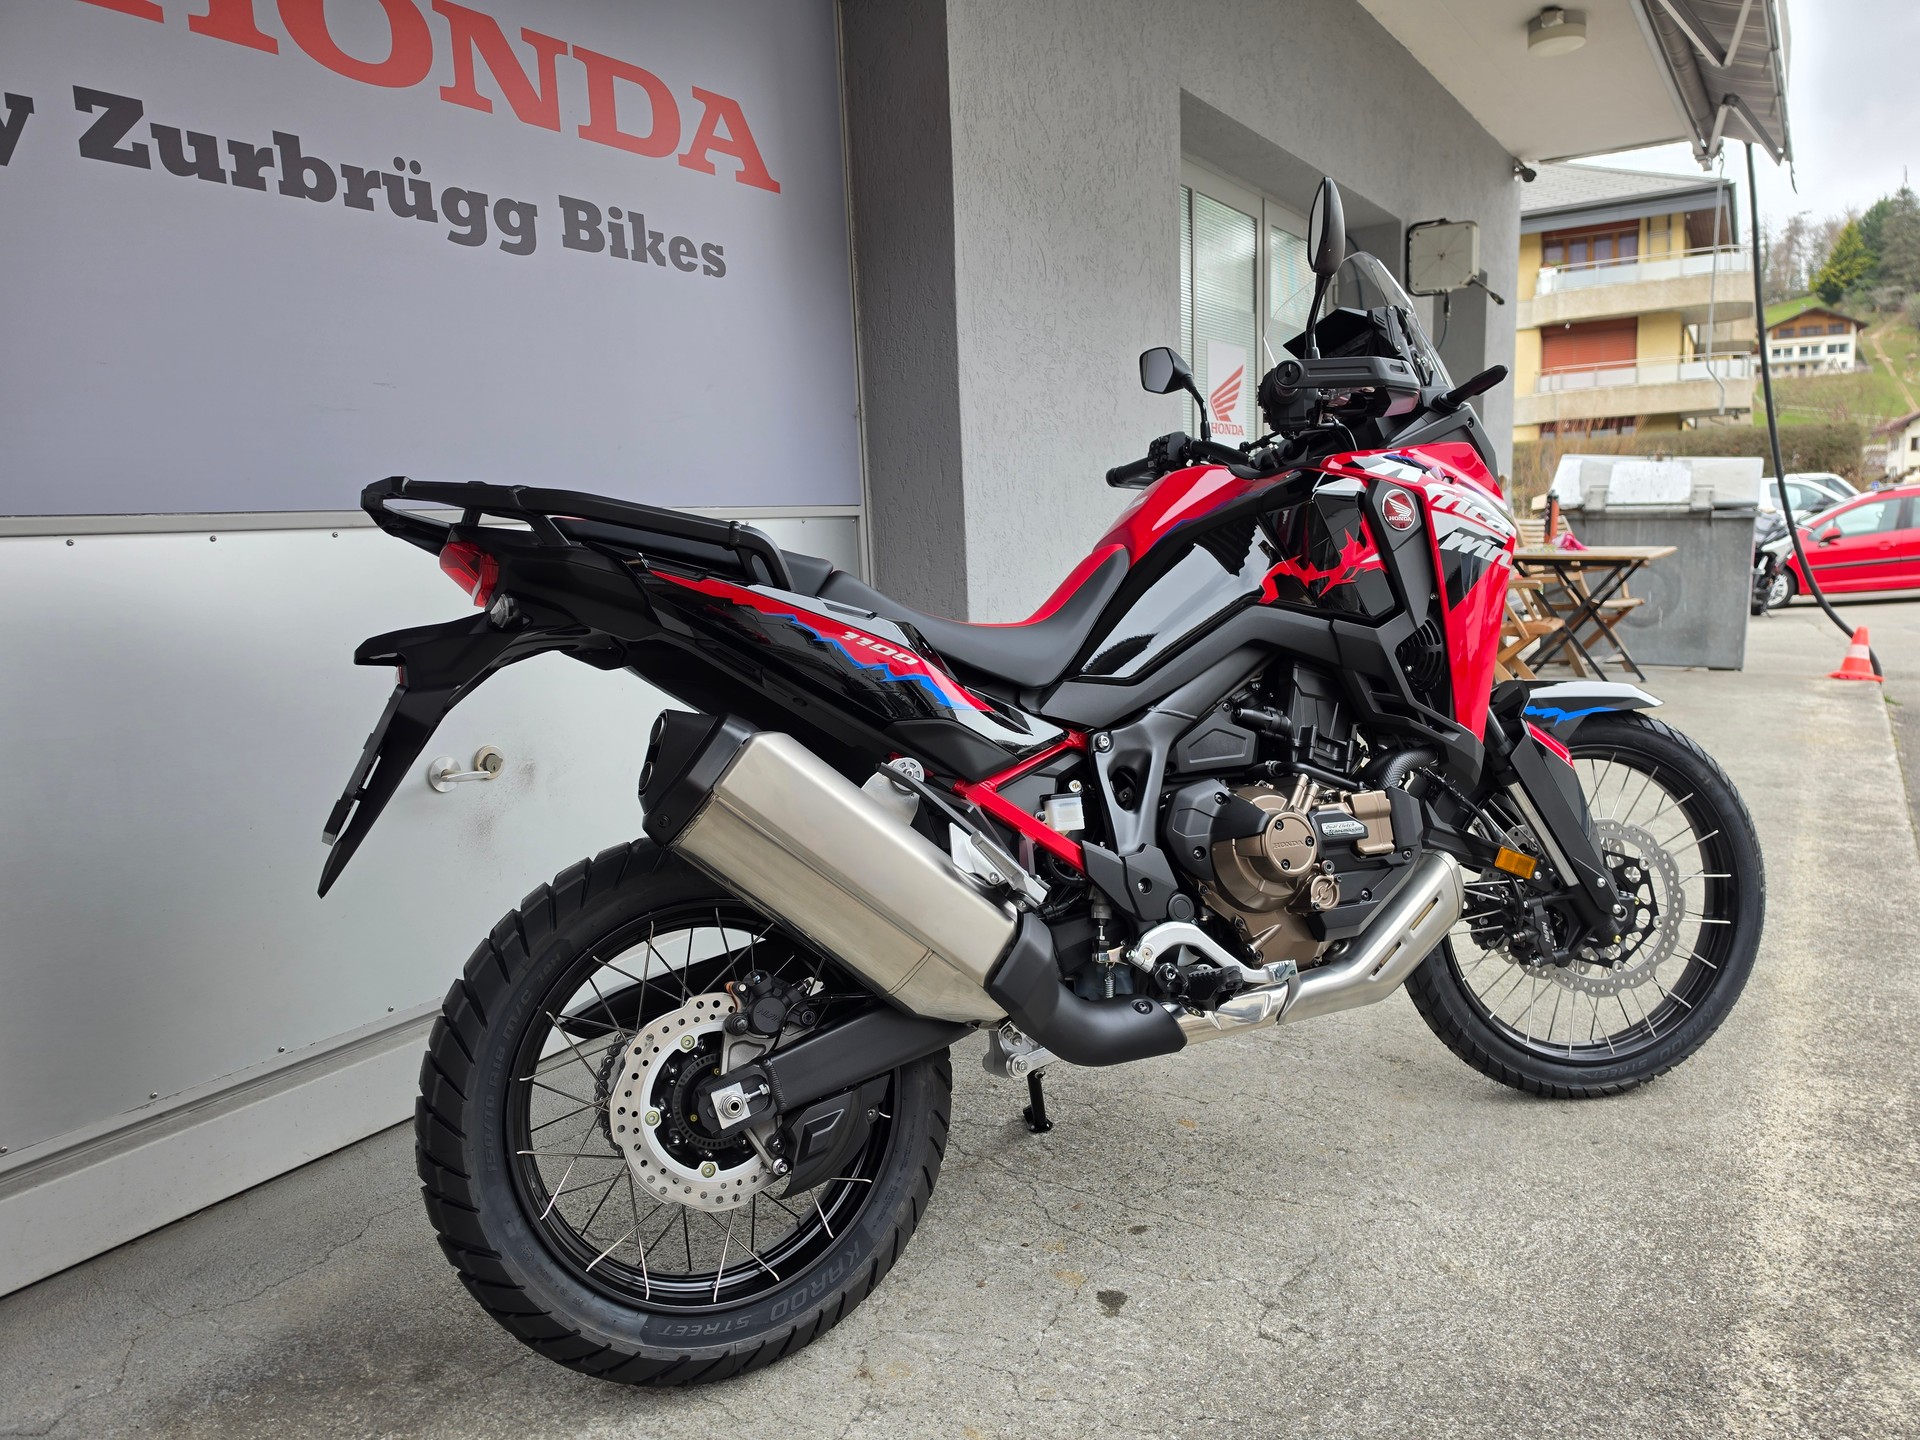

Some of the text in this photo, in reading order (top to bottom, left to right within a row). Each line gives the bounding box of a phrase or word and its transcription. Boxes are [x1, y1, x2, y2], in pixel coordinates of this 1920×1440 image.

[72, 85, 538, 256] Zurbrügg
[558, 194, 727, 278] Bikes
[1210, 422, 1244, 436] HONDA
[1388, 514, 1413, 522] HONDA
[841, 631, 919, 665] 1100
[1273, 840, 1306, 849] HONDA
[657, 1240, 861, 1337] KAROO STREET
